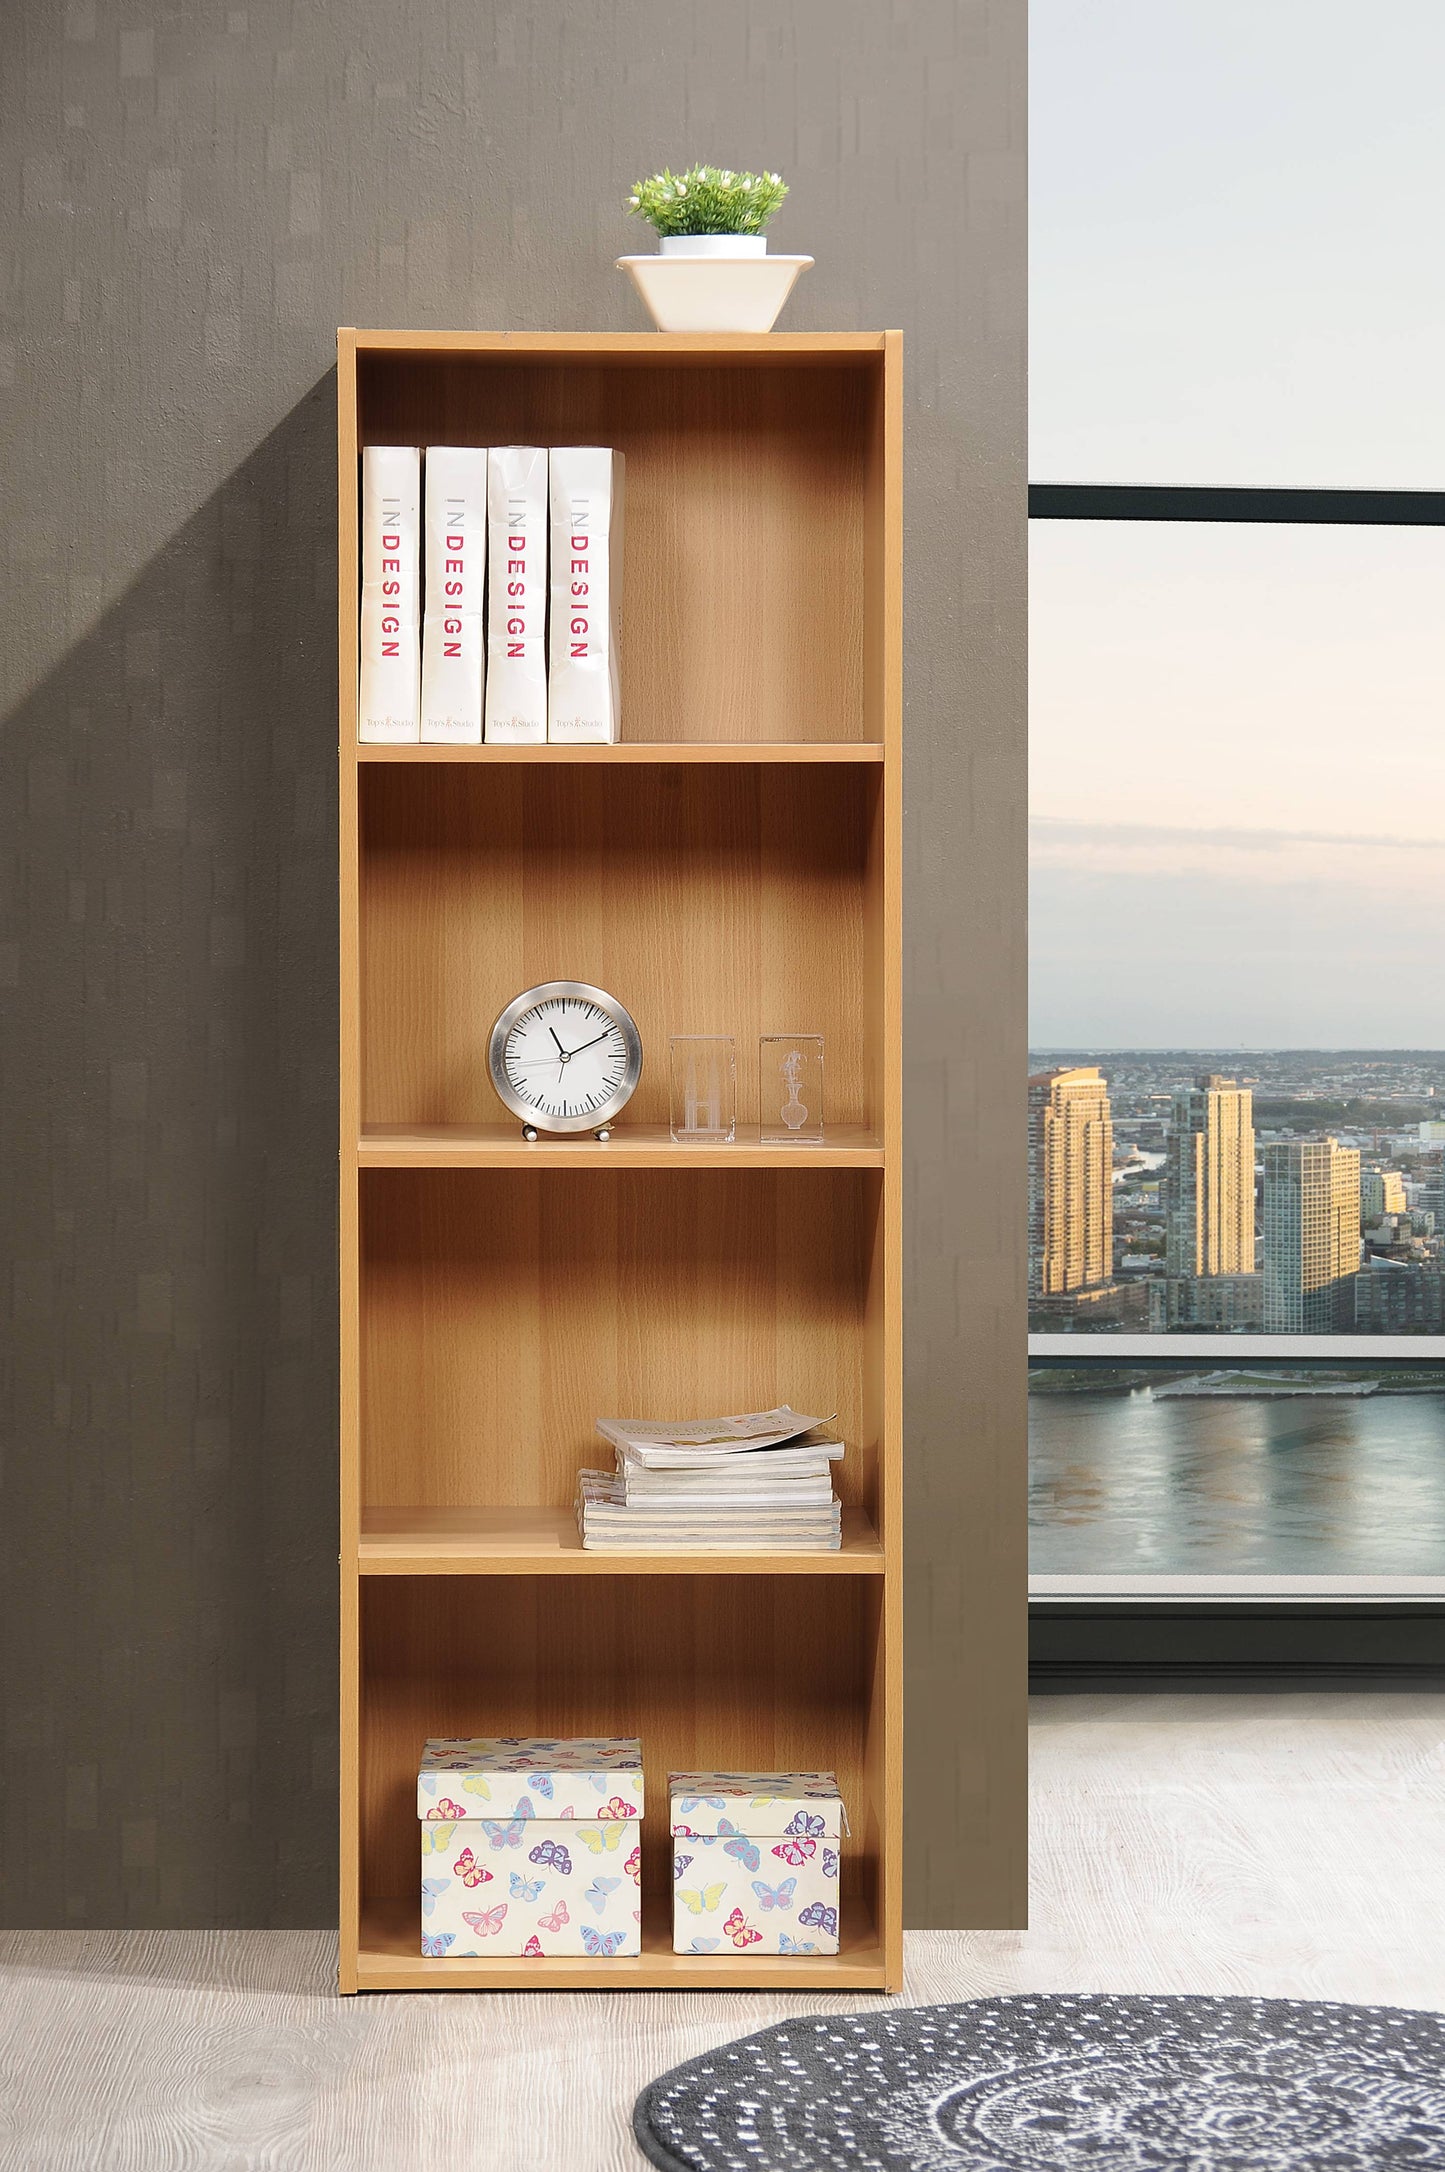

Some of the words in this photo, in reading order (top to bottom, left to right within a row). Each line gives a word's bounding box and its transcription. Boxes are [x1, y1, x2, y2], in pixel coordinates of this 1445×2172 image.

[381, 498, 401, 657] INDESIGN
[444, 498, 465, 658] INDESIGN
[507, 499, 526, 658] INDESIGN
[570, 499, 589, 659] INDESIGN
